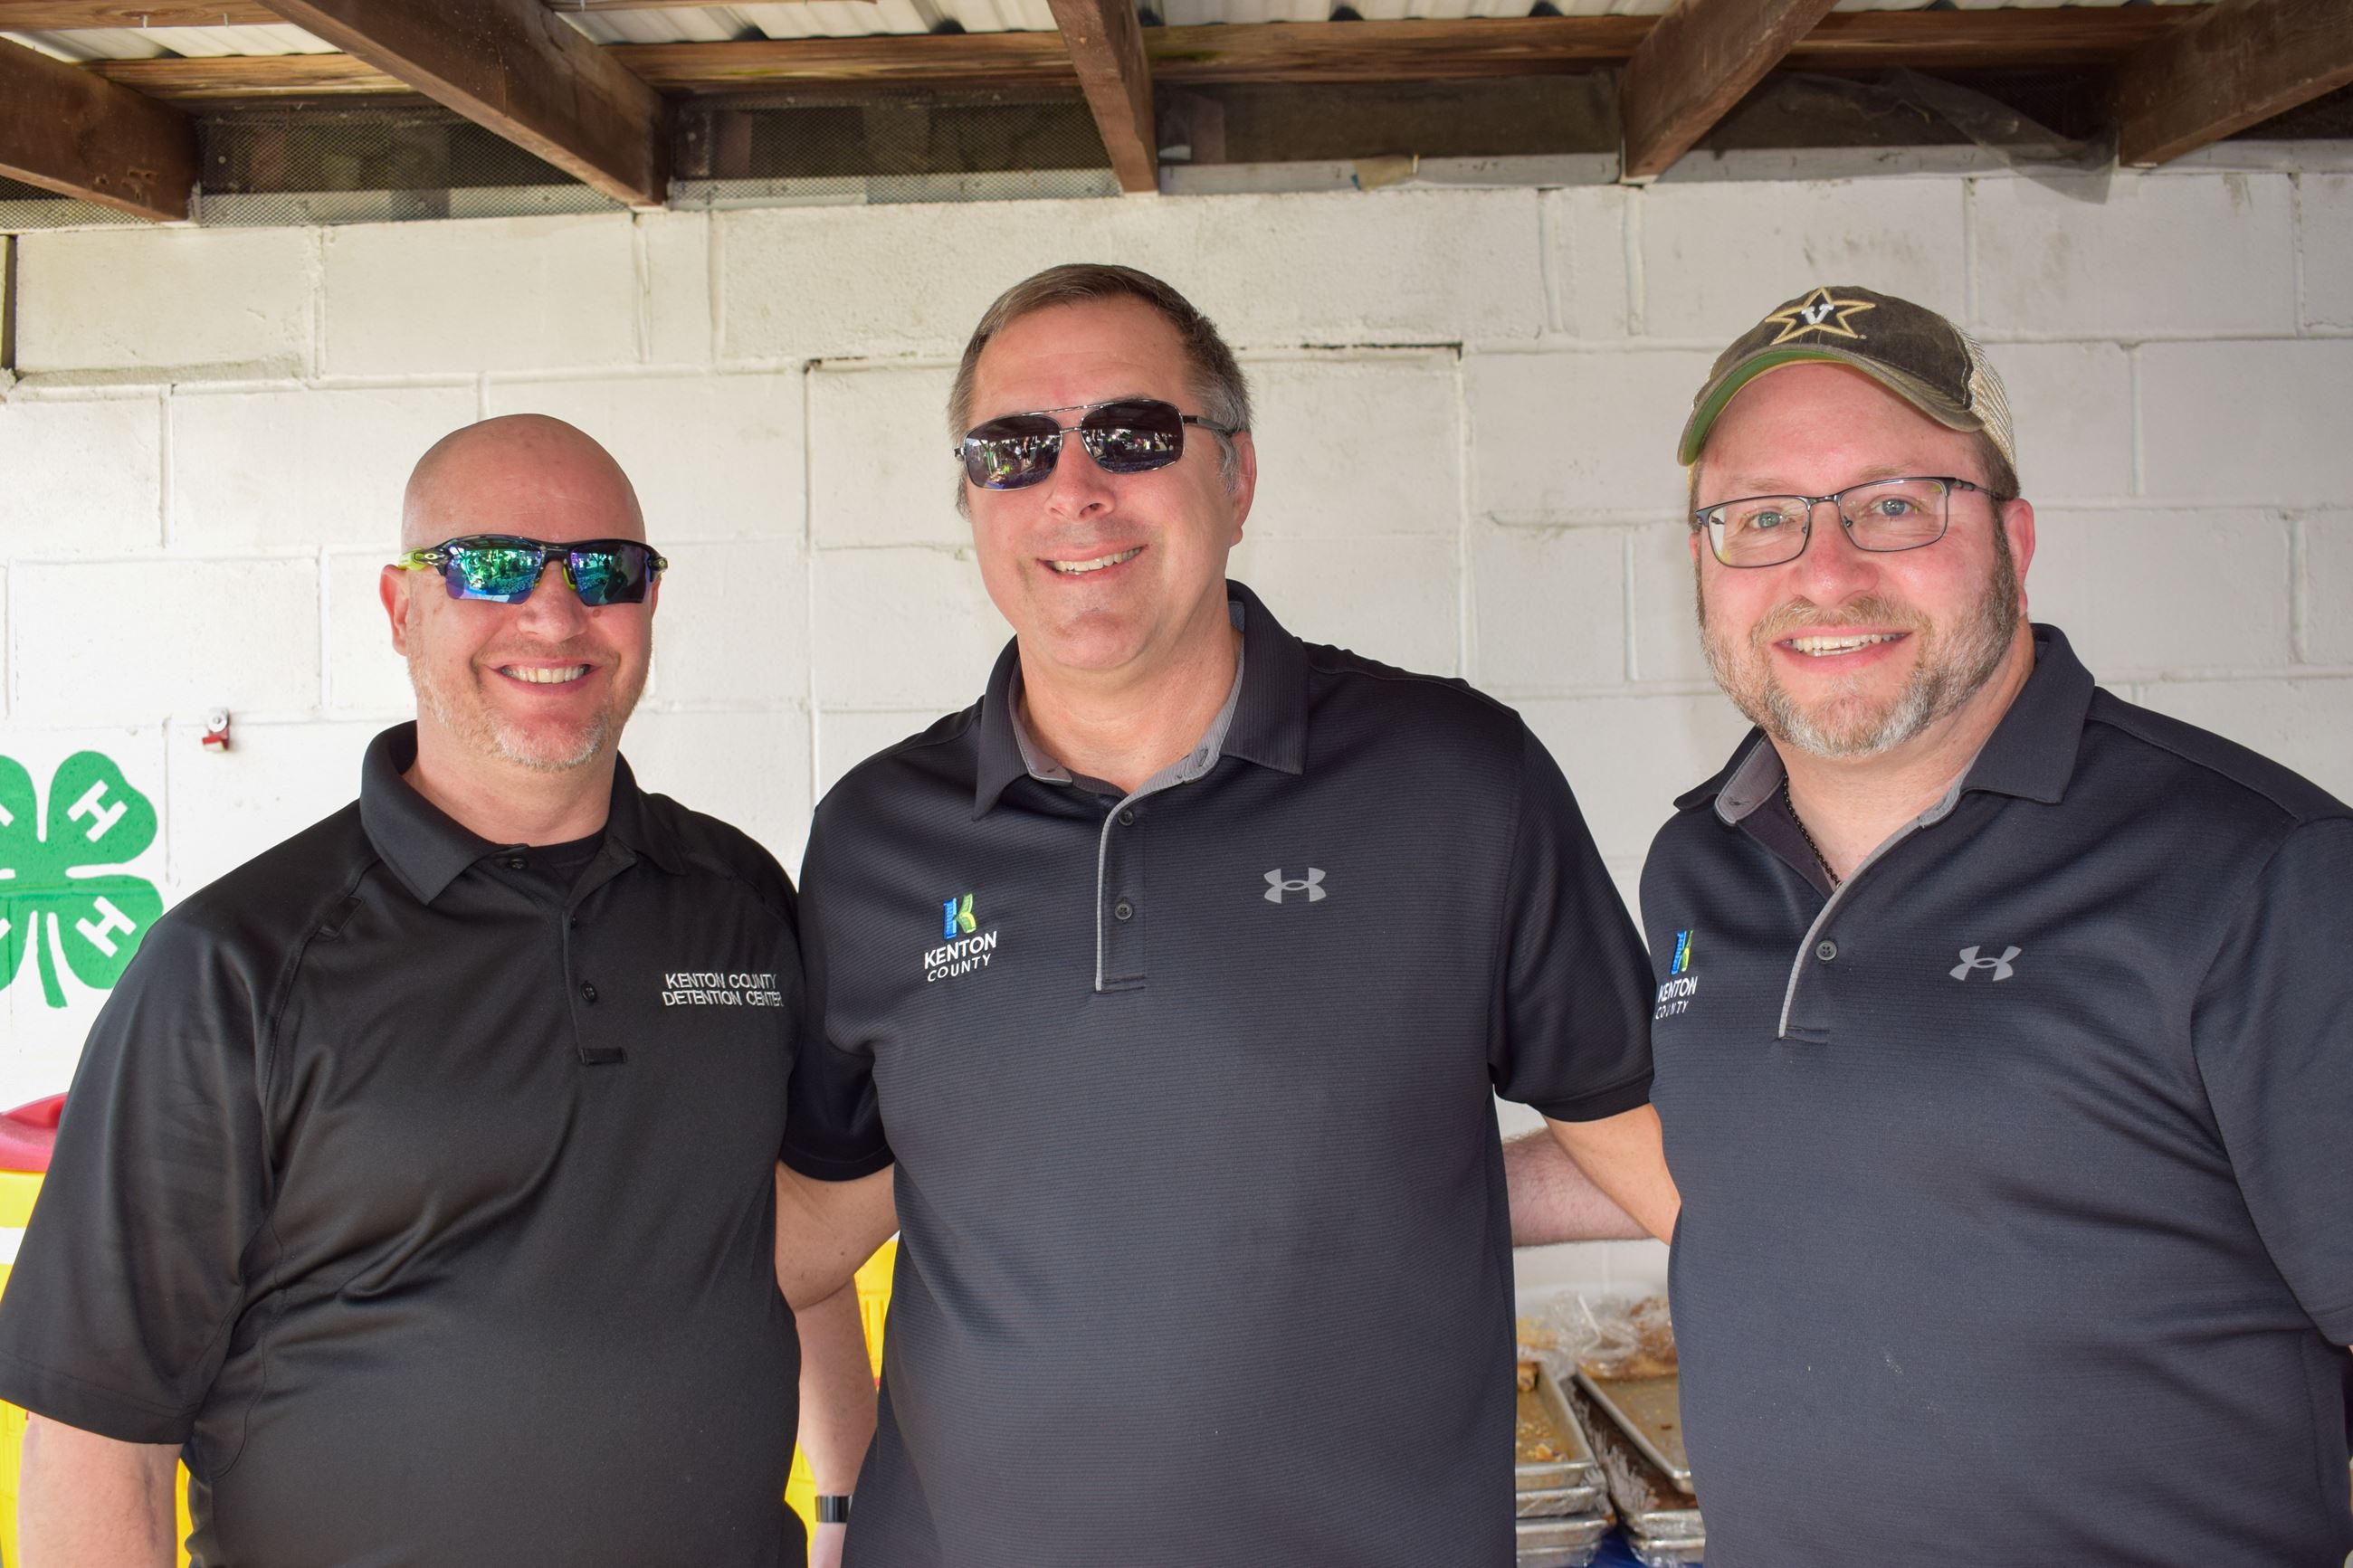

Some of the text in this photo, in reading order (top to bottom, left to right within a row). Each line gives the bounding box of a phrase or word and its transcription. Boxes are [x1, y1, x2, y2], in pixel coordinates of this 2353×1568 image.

[1801, 303, 1834, 325] V
[67, 779, 128, 842] H
[75, 896, 137, 957] H
[924, 930, 997, 970] KENTON
[665, 973, 776, 989] KENTON COUNTY
[927, 953, 991, 983] COUNTY
[662, 990, 784, 1007] DETENTION CENTER
[1657, 975, 1698, 1003] KENTON
